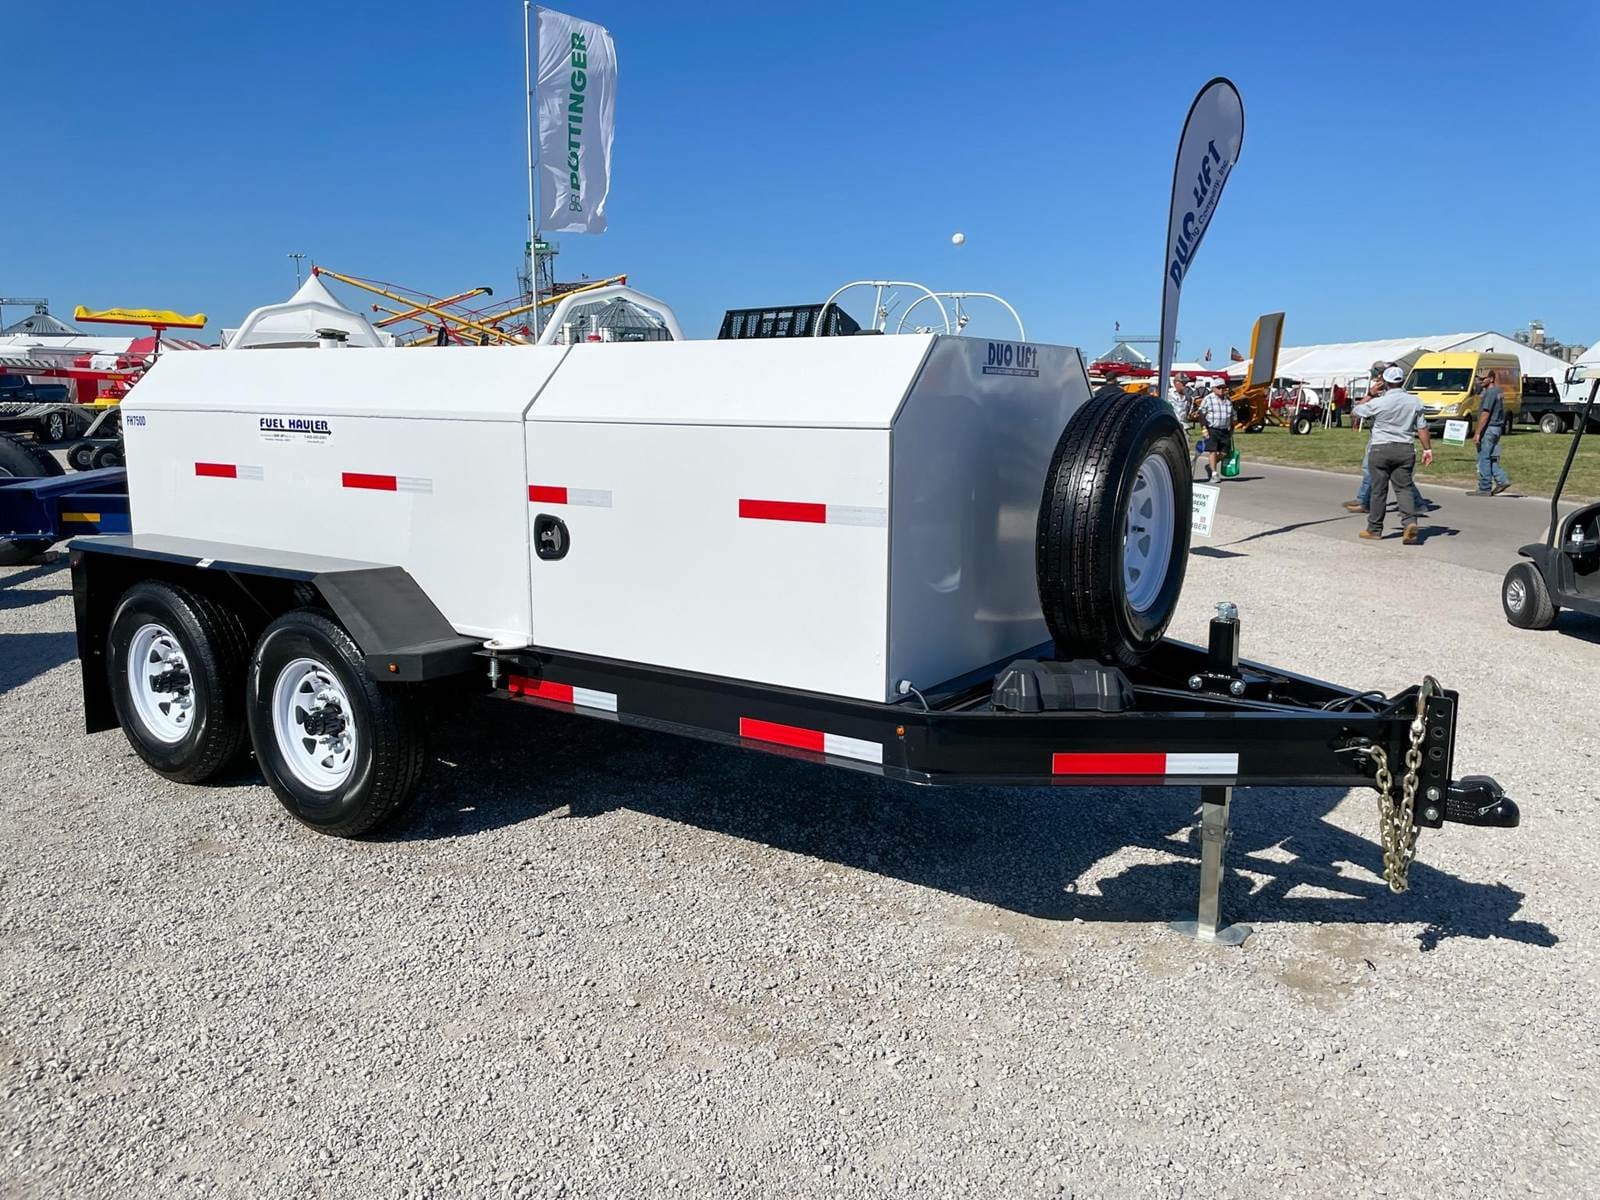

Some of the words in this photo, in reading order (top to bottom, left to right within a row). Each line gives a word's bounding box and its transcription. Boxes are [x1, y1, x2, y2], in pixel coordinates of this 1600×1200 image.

[1193, 139, 1221, 208] LIFT
[988, 343, 1013, 366] DUO
[1016, 345, 1038, 368] LIFT
[260, 418, 285, 428] FUEL
[288, 419, 328, 433] HAULER
